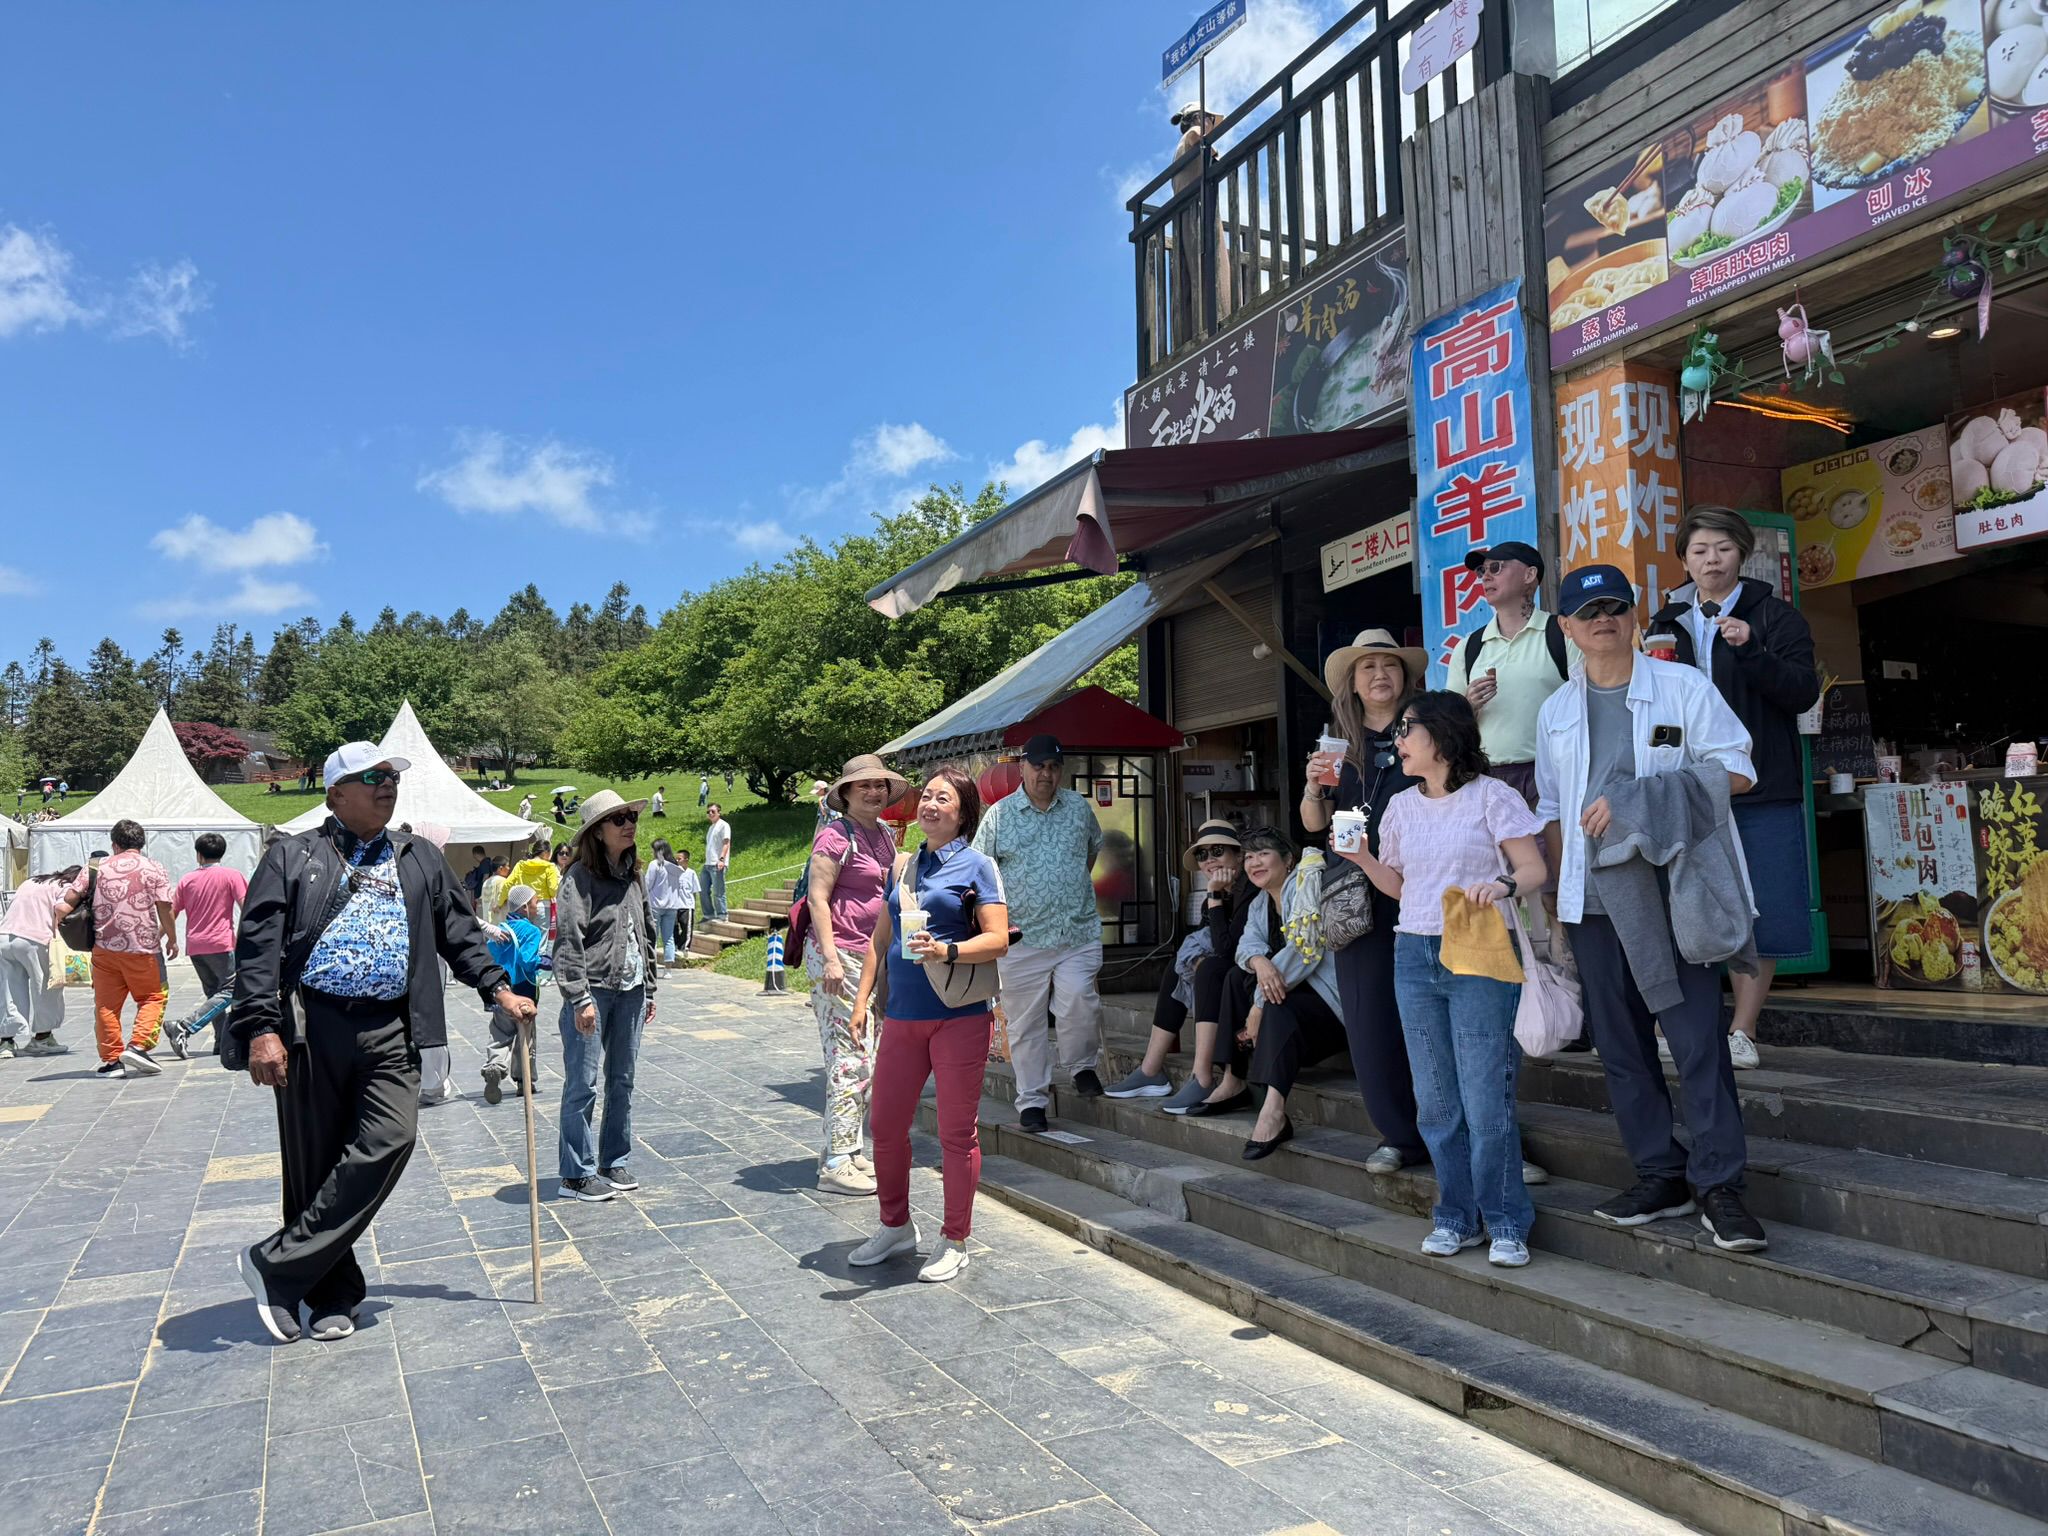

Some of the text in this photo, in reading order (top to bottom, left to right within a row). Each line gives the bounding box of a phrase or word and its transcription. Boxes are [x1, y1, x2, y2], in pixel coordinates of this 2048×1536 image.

[1866, 167, 1932, 216] 刨冰
[1871, 195, 1928, 226] SHAVED ICE
[1686, 253, 1796, 307] BELLY WRAPPED WITH MEAT
[1690, 232, 1790, 293] 草原肚包肉
[1571, 322, 1639, 357] STEAMED DUMPLING
[1424, 298, 1525, 667] 高山羊肉
[1560, 389, 1609, 562] 现炸
[1351, 521, 1410, 565] 二楼入口
[1978, 513, 2024, 536] 肚包肉
[1355, 563, 1373, 574] Second
[1385, 551, 1407, 564] entrance
[1582, 574, 1602, 588] ADT
[1909, 788, 1938, 885] 肚包肉
